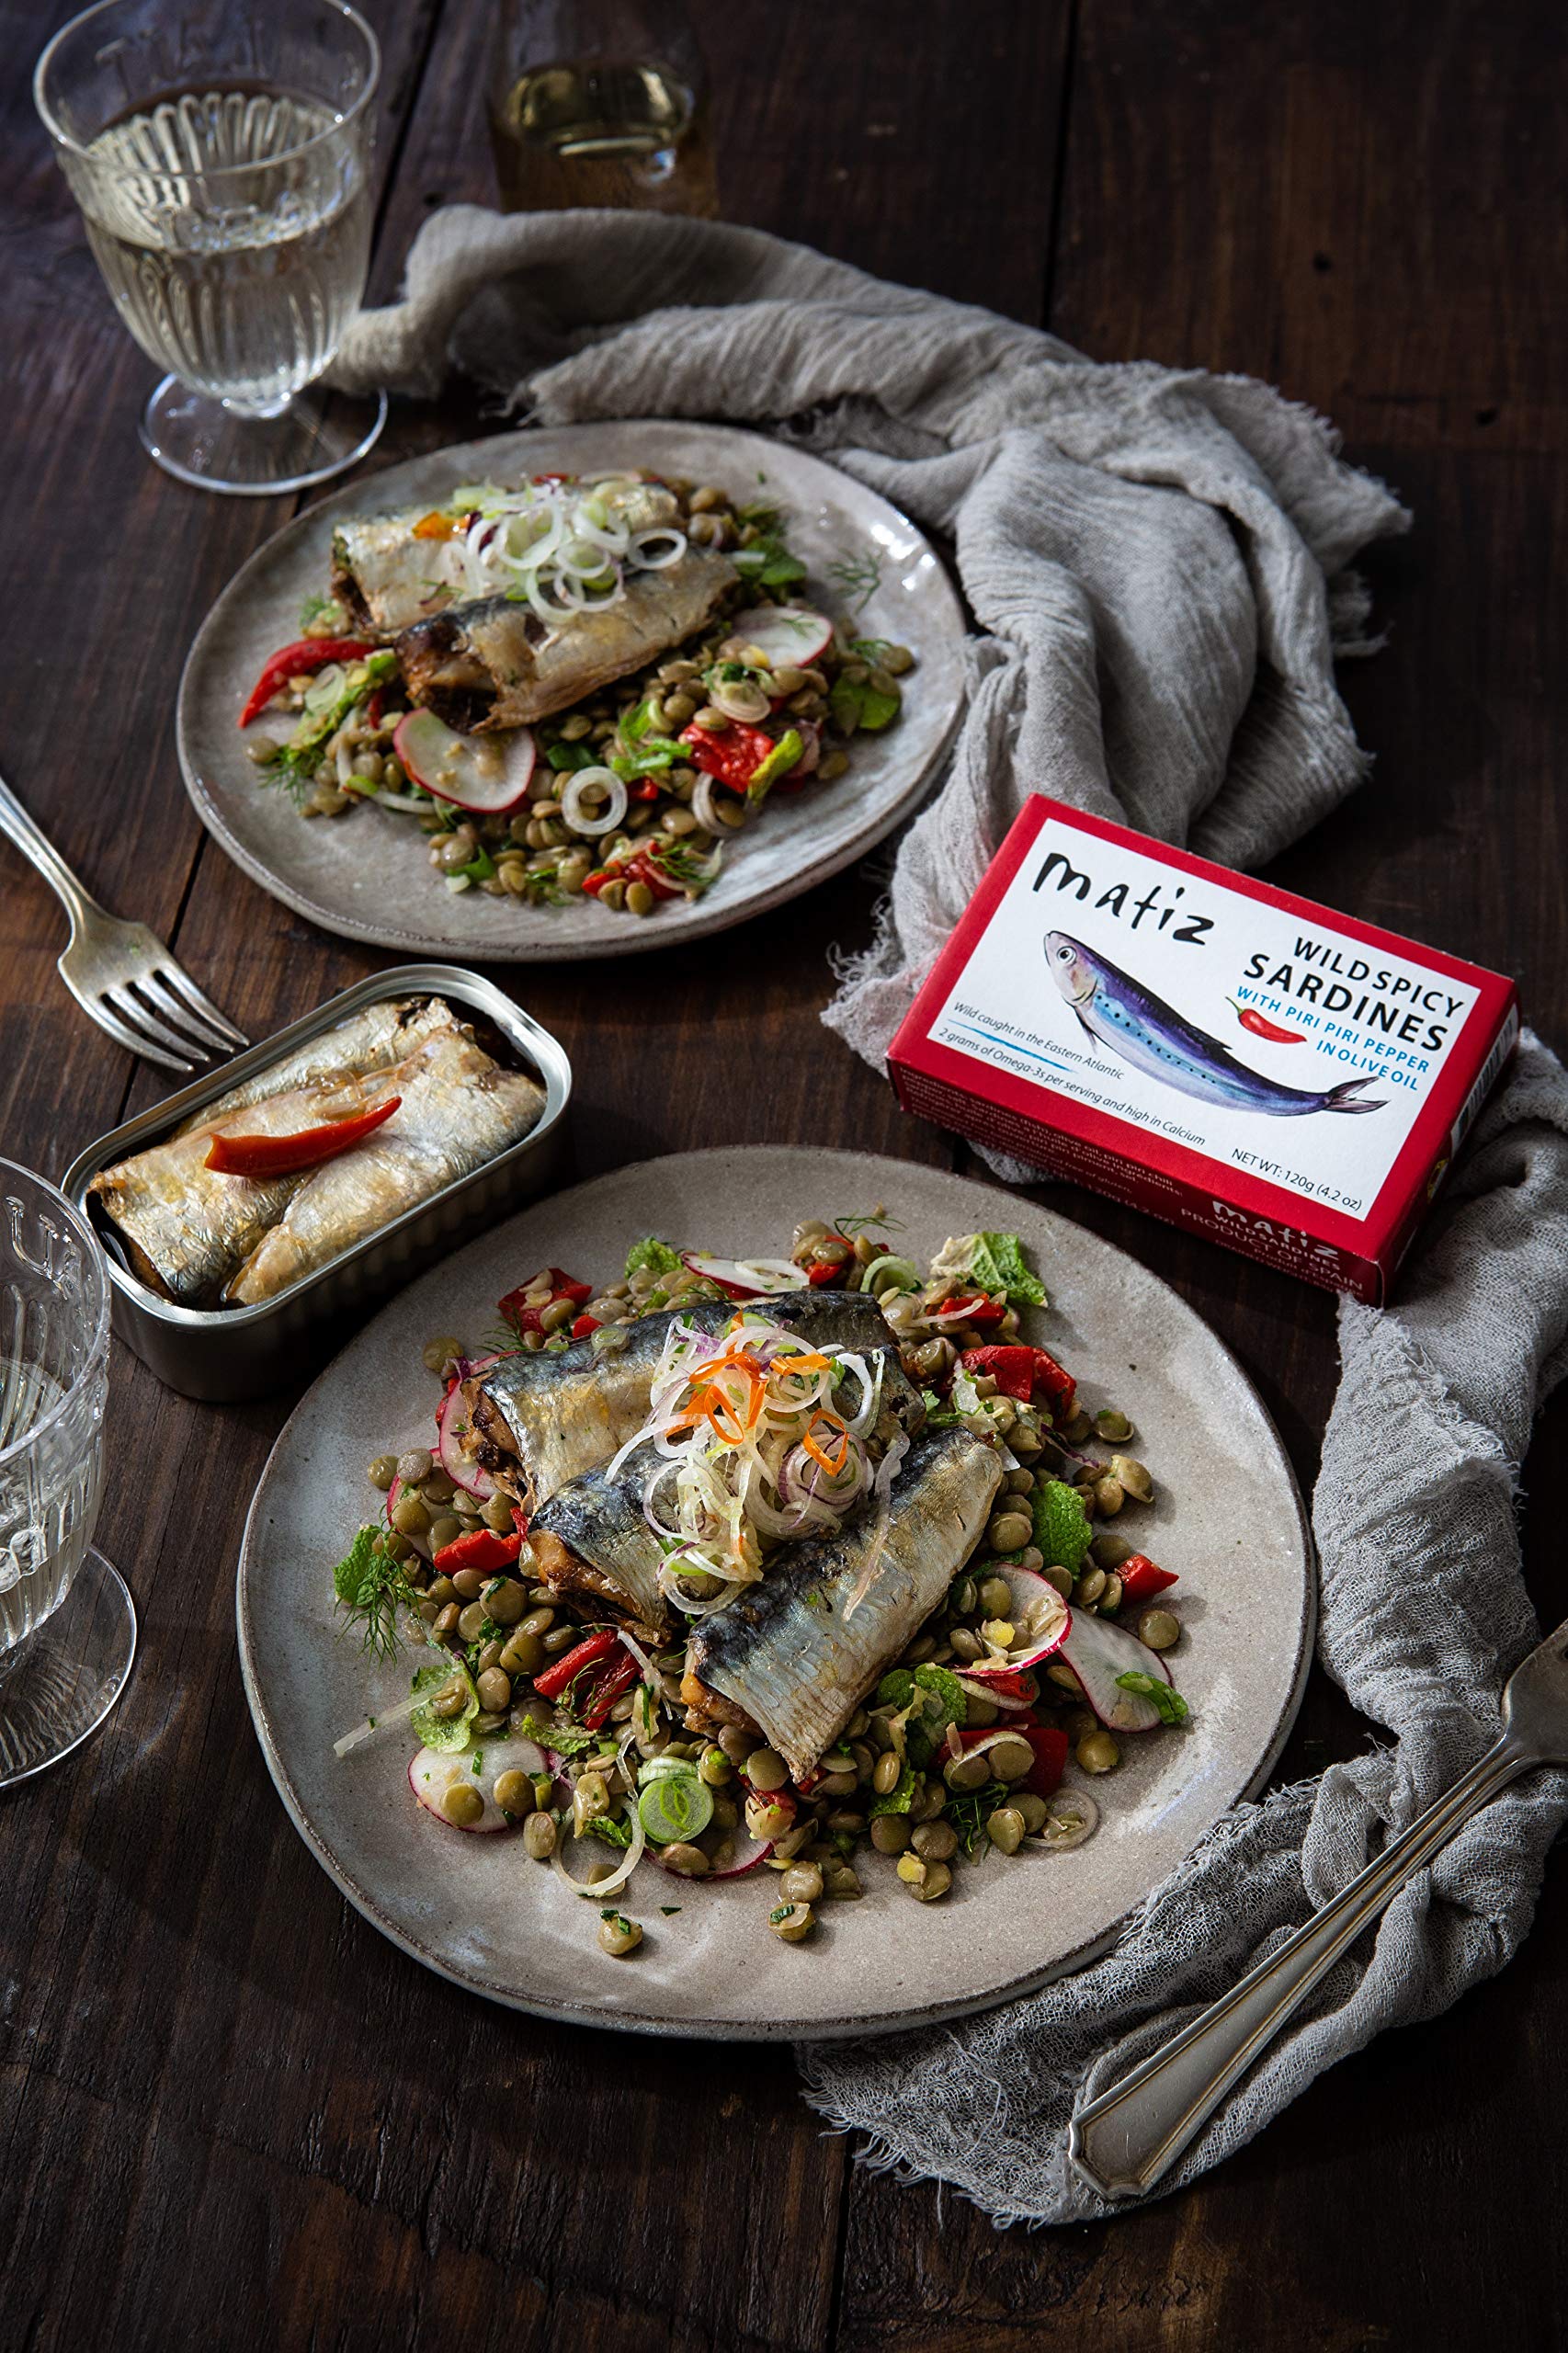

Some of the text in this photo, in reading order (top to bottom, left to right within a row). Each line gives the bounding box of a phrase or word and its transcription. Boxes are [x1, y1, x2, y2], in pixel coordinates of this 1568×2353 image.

[1032, 852, 1214, 946] matiz
[1244, 953, 1449, 1051] SARDINES
[1293, 937, 1465, 1018] WILD SPICY
[954, 1002, 1125, 1080] Wild caught in the Eastern Atlantic
[1237, 985, 1430, 1073] WITH PIRI PIRI PEPPER
[1316, 1040, 1418, 1091] IN OLIVE OIL
[938, 1028, 1206, 1146] 2 grams of Omega-3s per serving and high in Calcium
[1232, 1148, 1362, 1211] NET WT: 120g (4.2 oz)
[1181, 1208, 1273, 1252] PRODUCT
[1278, 1249, 1303, 1264] OF
[1309, 1262, 1363, 1290] SPAIN
[1212, 1200, 1339, 1261] matiz
[1215, 1214, 1340, 1271] WILD SARDINES
